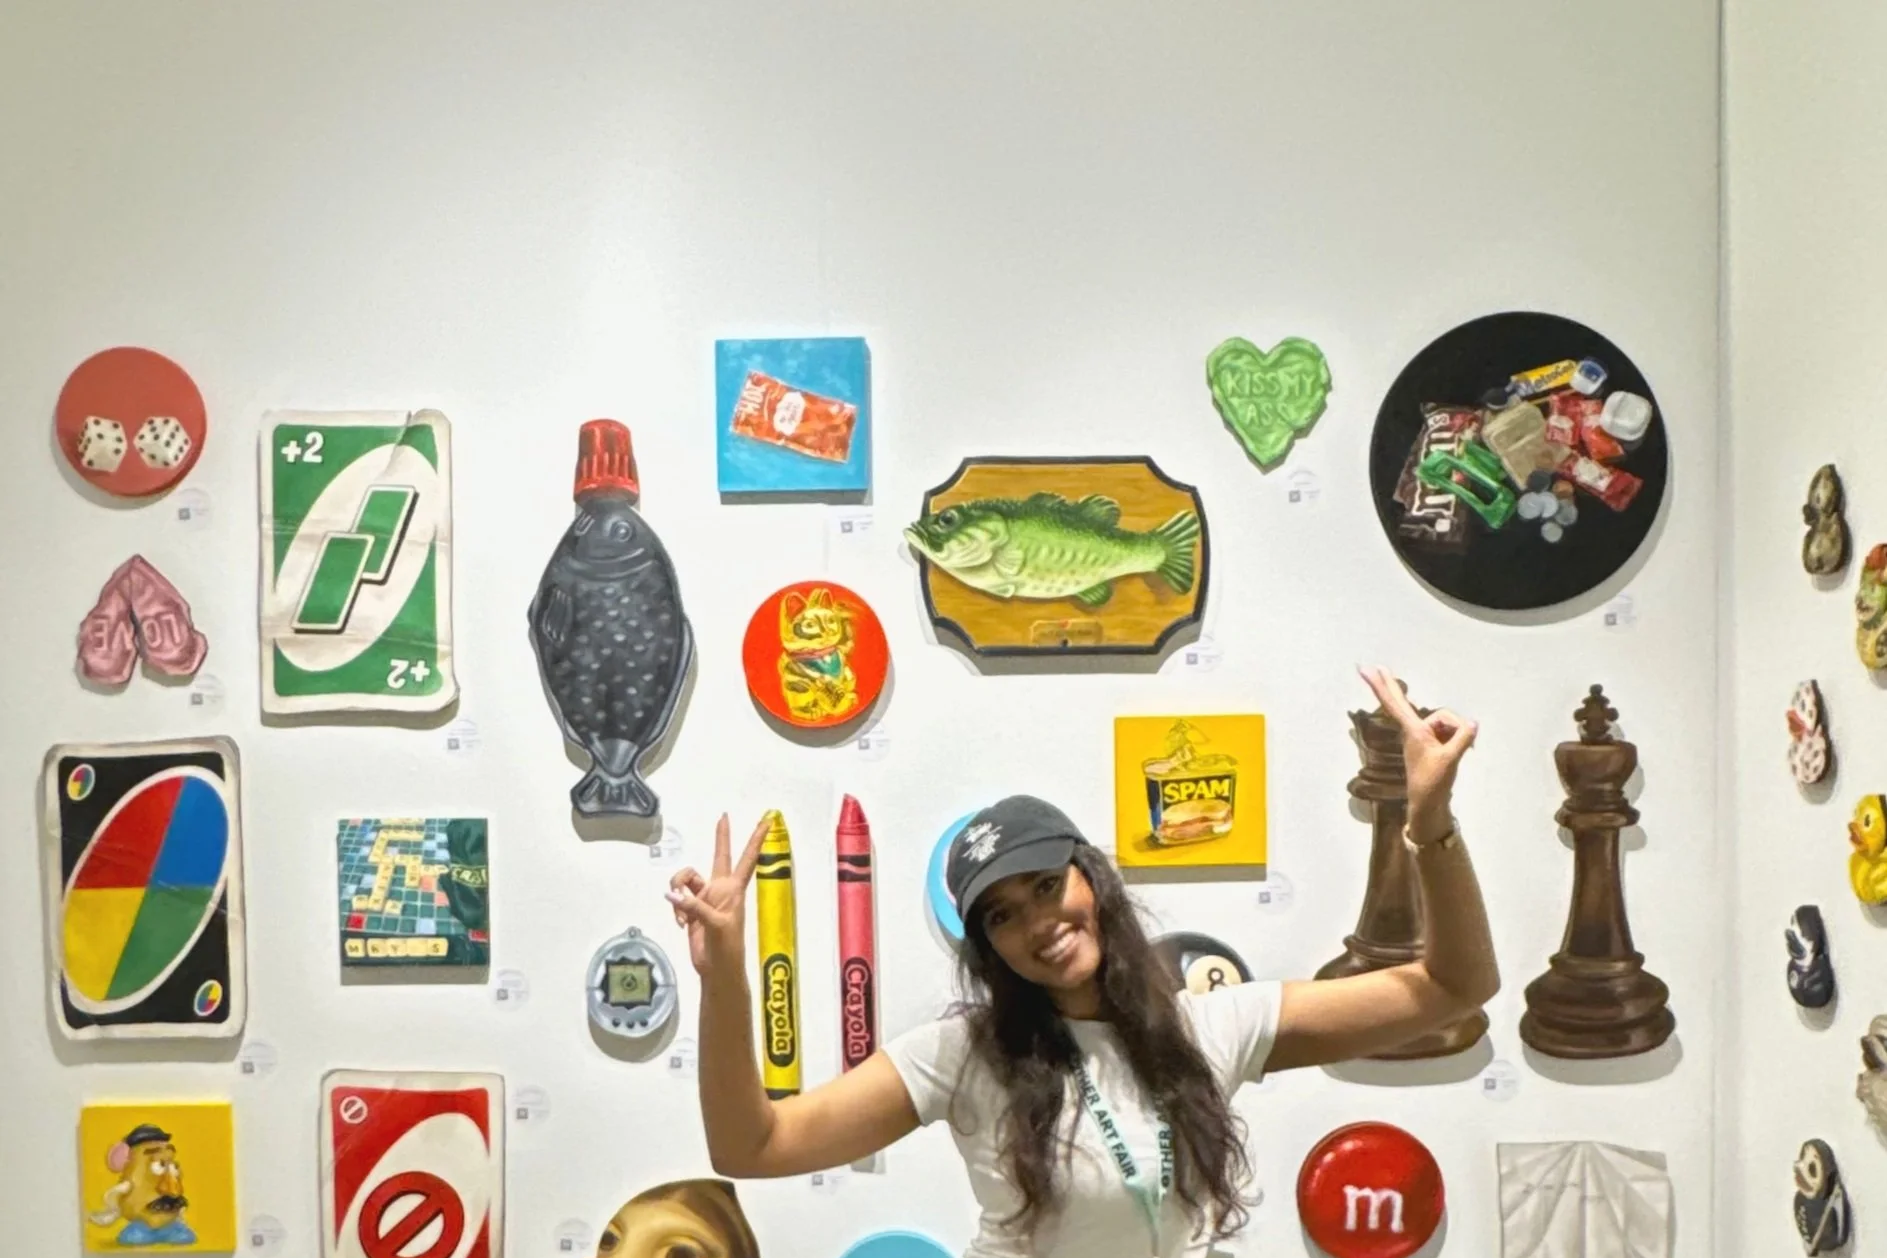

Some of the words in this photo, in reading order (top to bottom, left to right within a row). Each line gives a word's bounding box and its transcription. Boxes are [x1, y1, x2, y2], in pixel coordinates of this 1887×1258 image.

[1220, 369, 1280, 396] KISS
[1280, 370, 1317, 397] MY
[280, 431, 325, 464] +2
[1164, 778, 1231, 804] SPAM
[767, 961, 793, 1056] Crayola
[845, 964, 870, 1059] Crayola
[1095, 1109, 1120, 1141] ART
[1111, 1142, 1138, 1179] FAIR
[1158, 1129, 1174, 1188] OTHER
[1343, 1184, 1405, 1234] m
